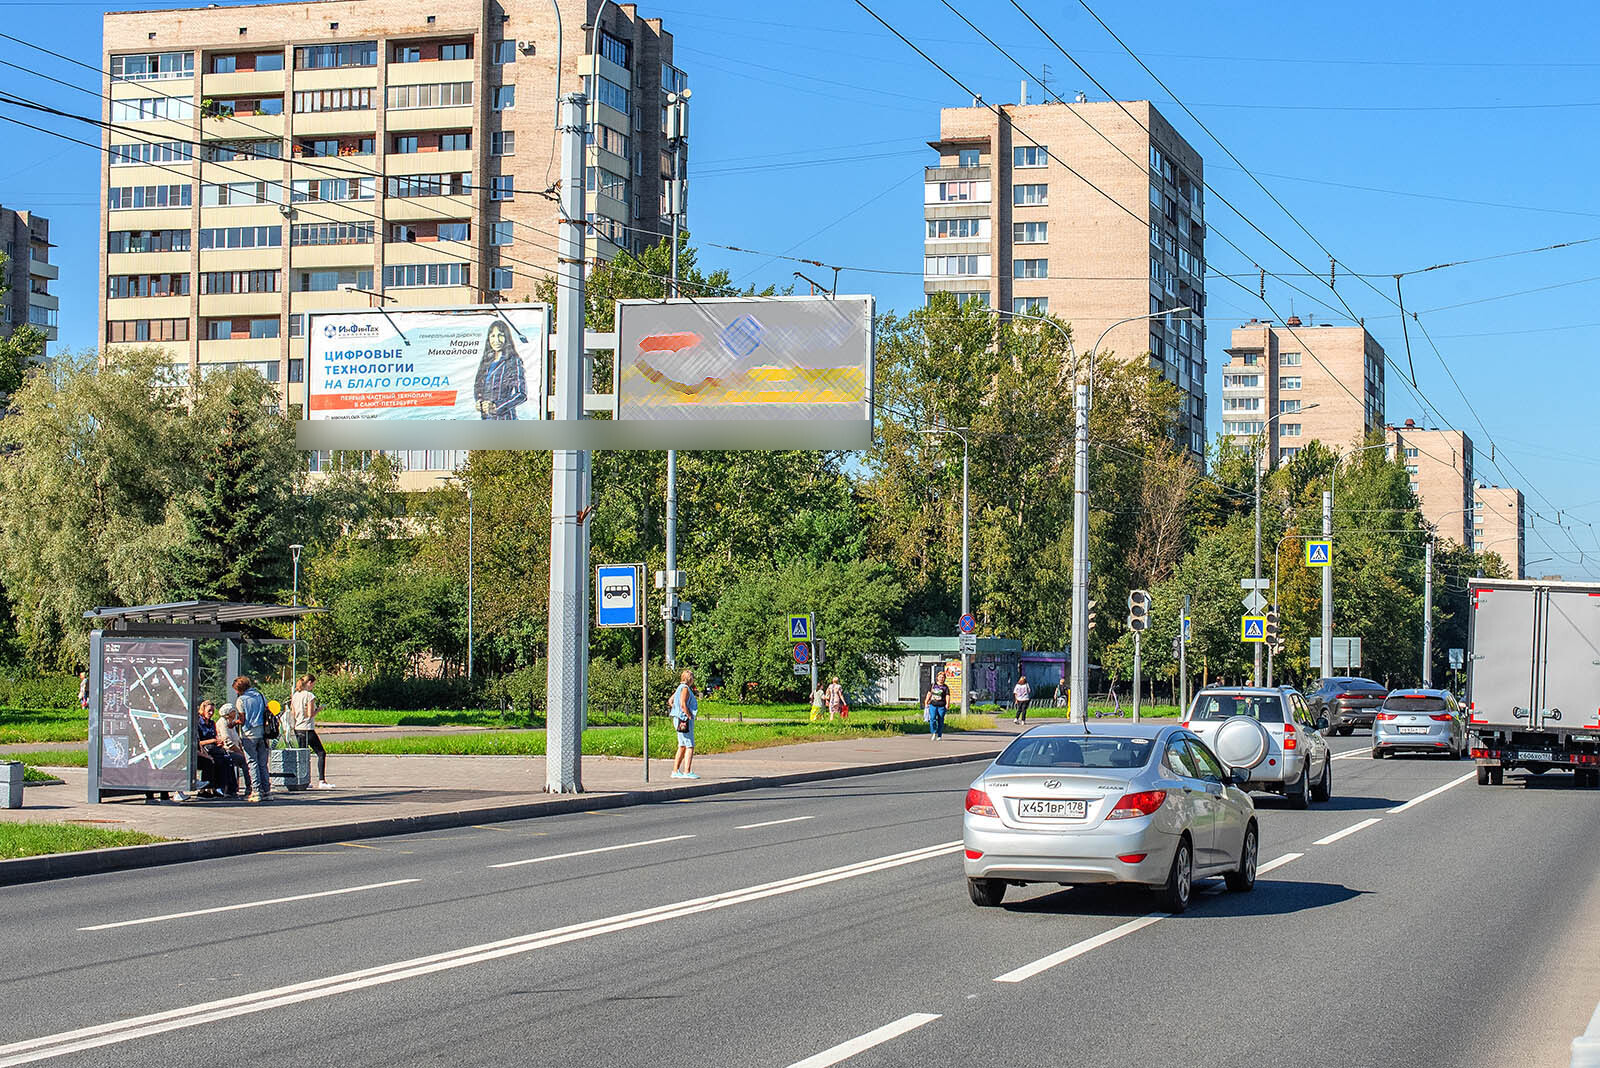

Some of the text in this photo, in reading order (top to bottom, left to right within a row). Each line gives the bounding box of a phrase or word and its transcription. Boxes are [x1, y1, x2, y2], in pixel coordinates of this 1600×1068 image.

[449, 340, 480, 348] Мария
[325, 350, 403, 362] ЦИФРОВЫЕ
[428, 347, 478, 356] Михайлова
[325, 363, 414, 375] ТЕХНОЛОГИИ
[324, 376, 450, 389] НА БЛАГО ГОРОДА
[1067, 801, 1084, 811] 178
